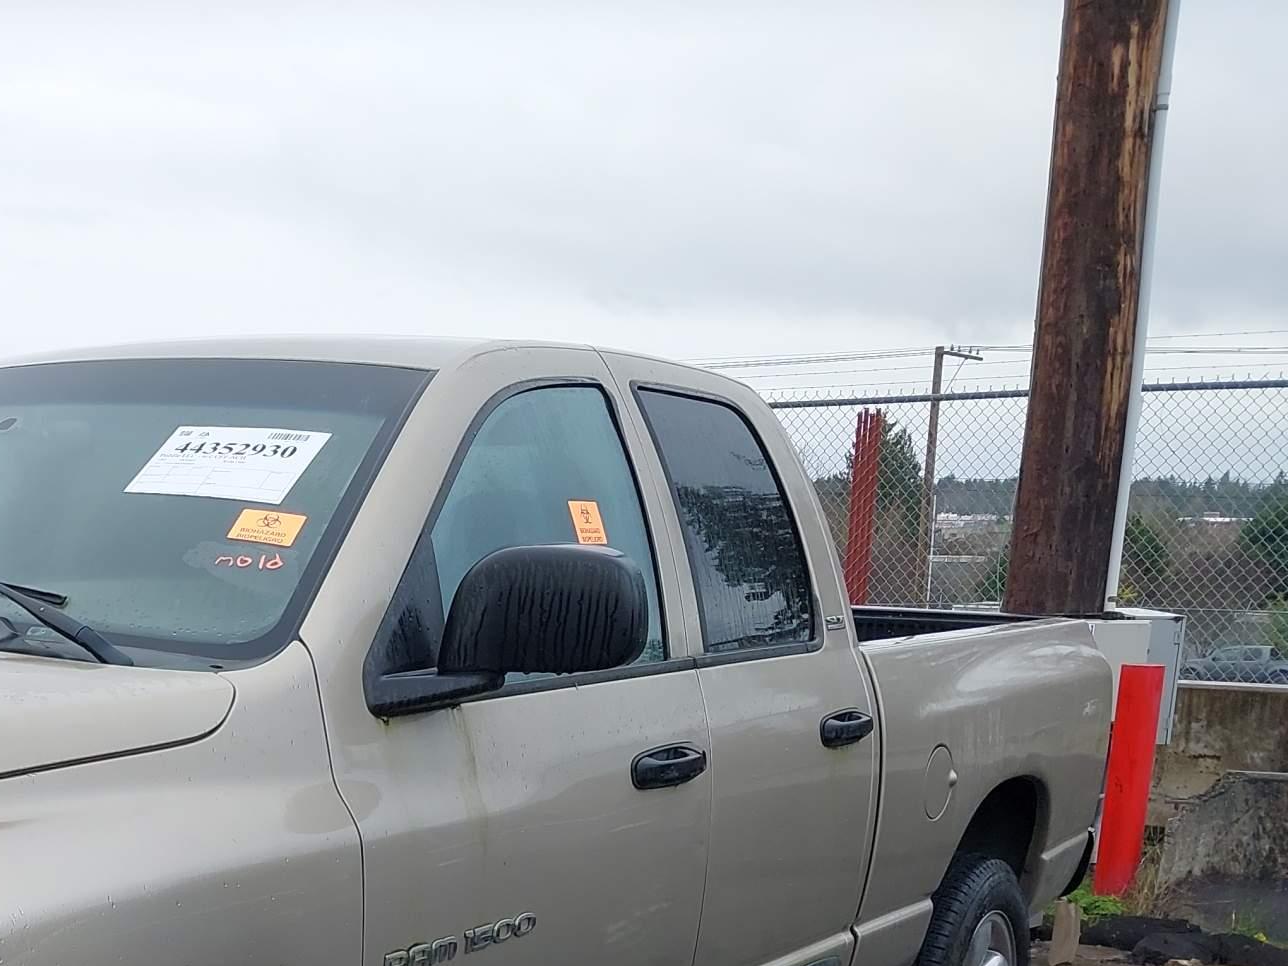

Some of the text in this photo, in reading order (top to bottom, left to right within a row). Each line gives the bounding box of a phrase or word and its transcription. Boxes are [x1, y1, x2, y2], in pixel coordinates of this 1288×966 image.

[175, 441, 298, 459] 44352930
[240, 527, 287, 538] BIOHAZARD
[215, 553, 284, 570] mold
[463, 911, 537, 954] 1500
